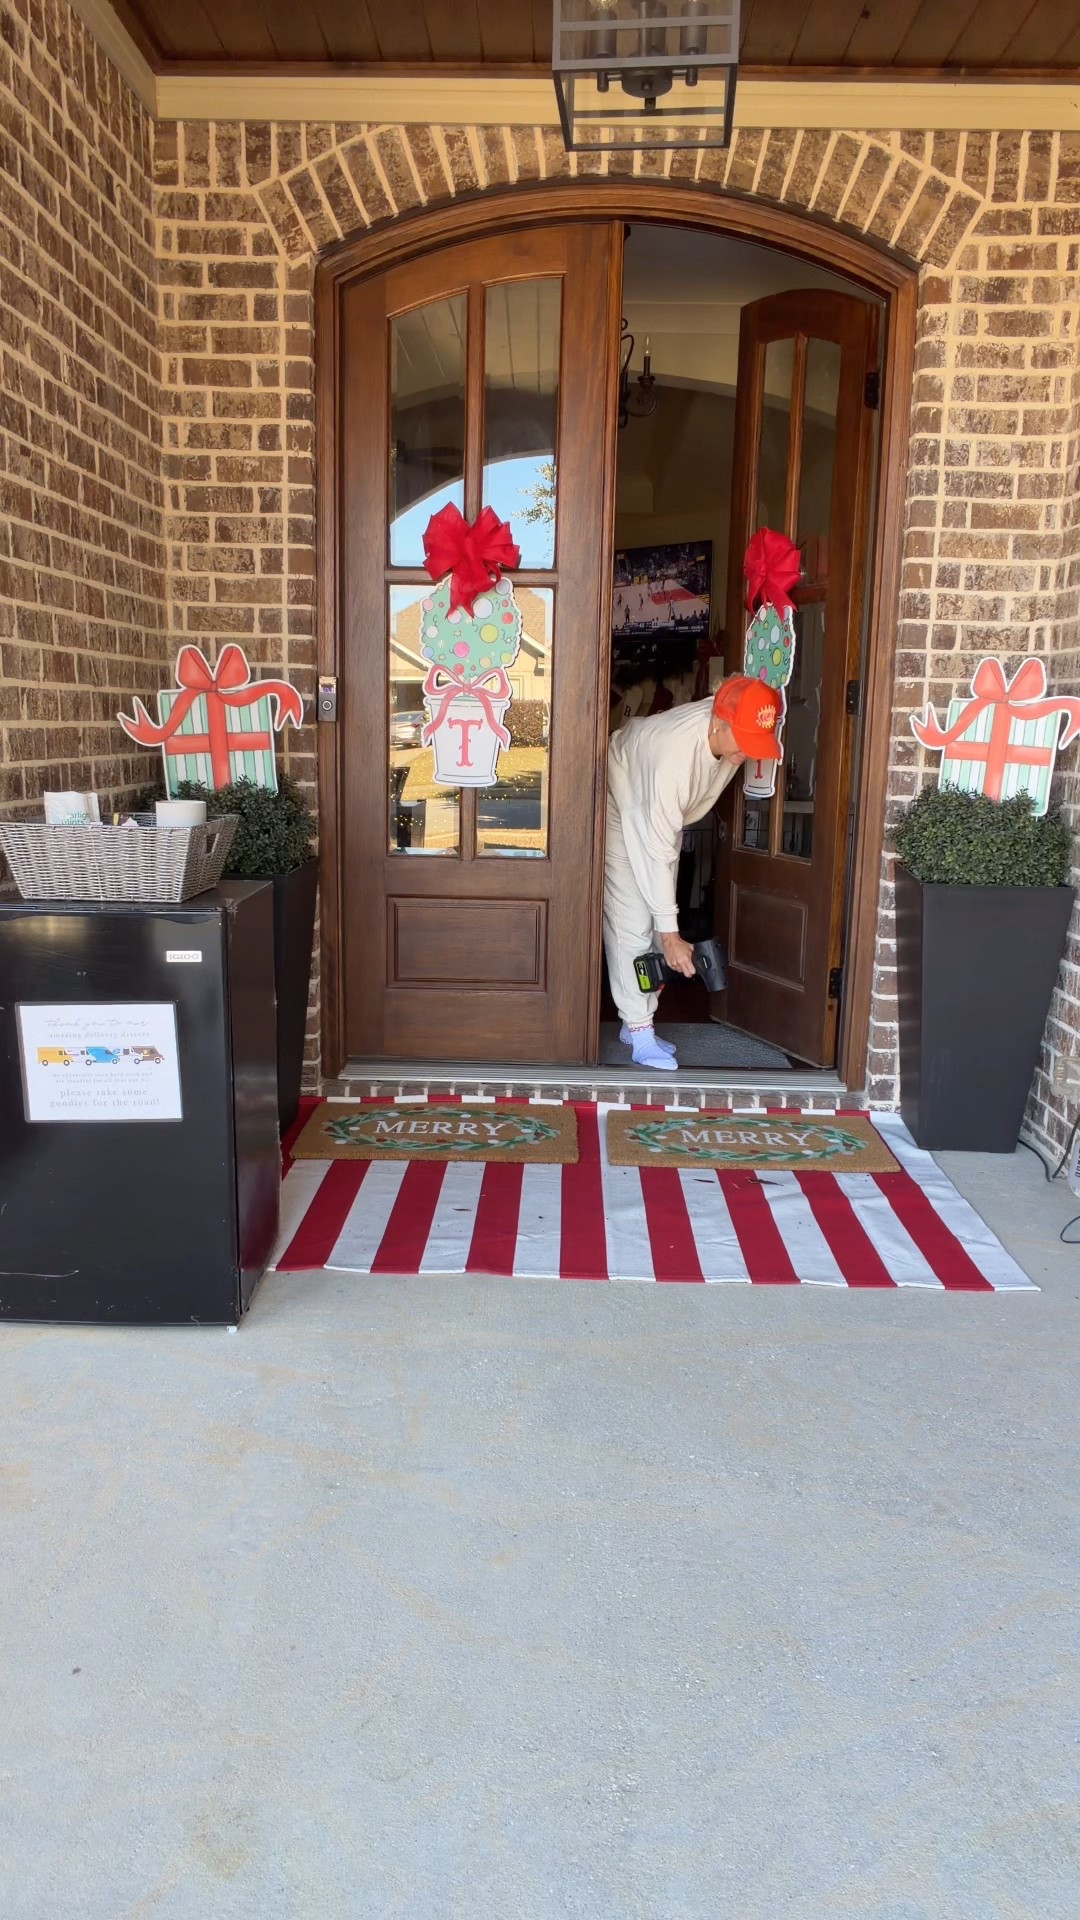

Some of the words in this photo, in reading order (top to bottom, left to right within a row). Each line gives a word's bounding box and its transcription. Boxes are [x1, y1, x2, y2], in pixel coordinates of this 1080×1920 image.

[447, 717, 484, 768] T
[60, 1088, 92, 1098] please
[96, 1088, 118, 1096] take
[50, 1098, 88, 1108] goodies
[92, 1098, 107, 1106] for
[112, 1097, 129, 1106] the
[133, 1098, 160, 1106] road!
[375, 1120, 506, 1136] MERRY
[679, 1129, 814, 1147] MERRY
